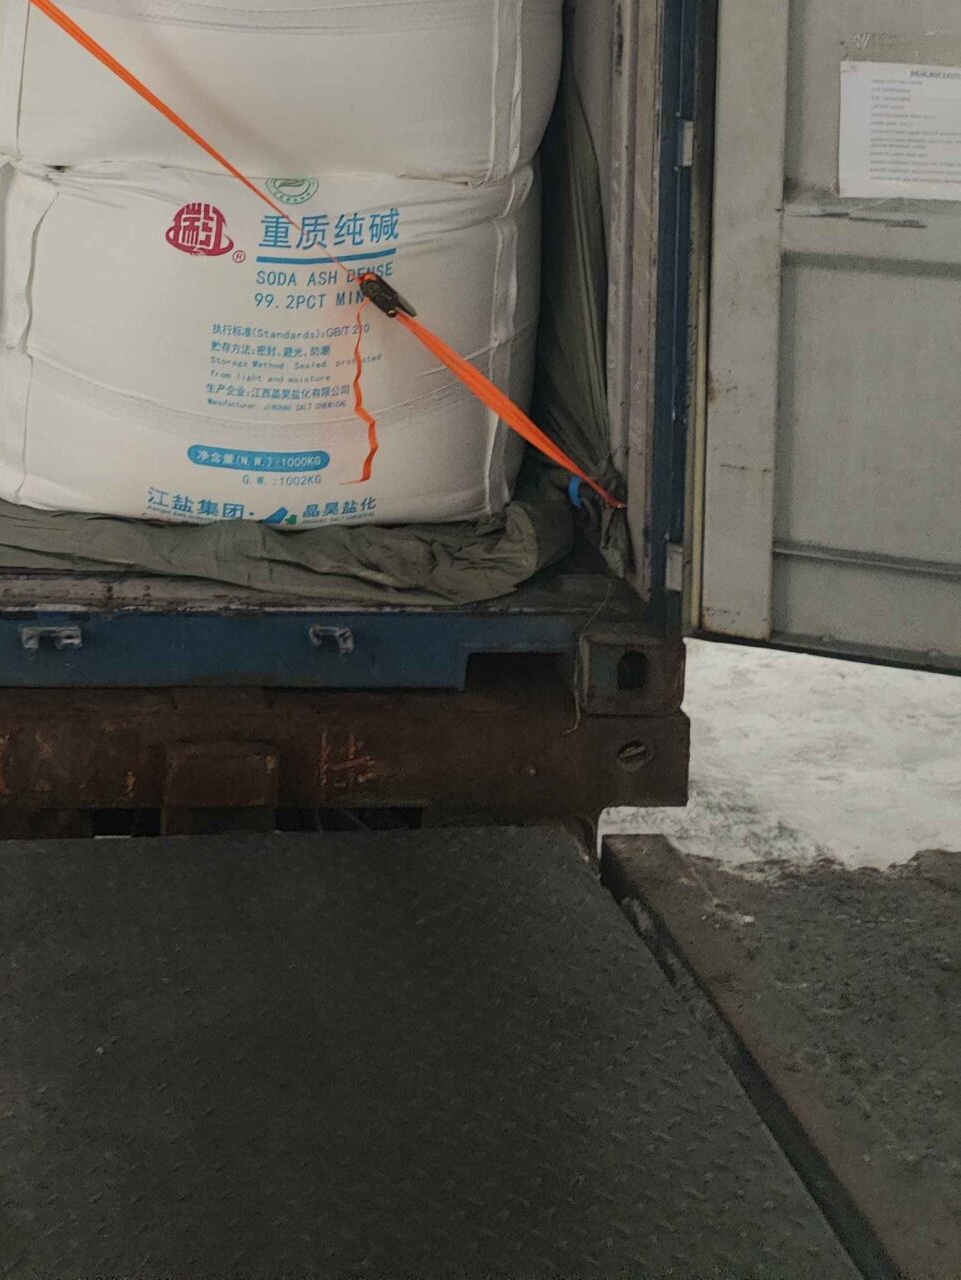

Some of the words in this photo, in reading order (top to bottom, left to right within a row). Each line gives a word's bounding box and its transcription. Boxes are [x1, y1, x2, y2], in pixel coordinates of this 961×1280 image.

[258, 208, 400, 250] 重质纯碱
[256, 270, 297, 287] SODA
[307, 267, 338, 285] ASH
[254, 293, 327, 310] 99.2PCT
[336, 291, 365, 306] MIN
[352, 323, 370, 336] 20
